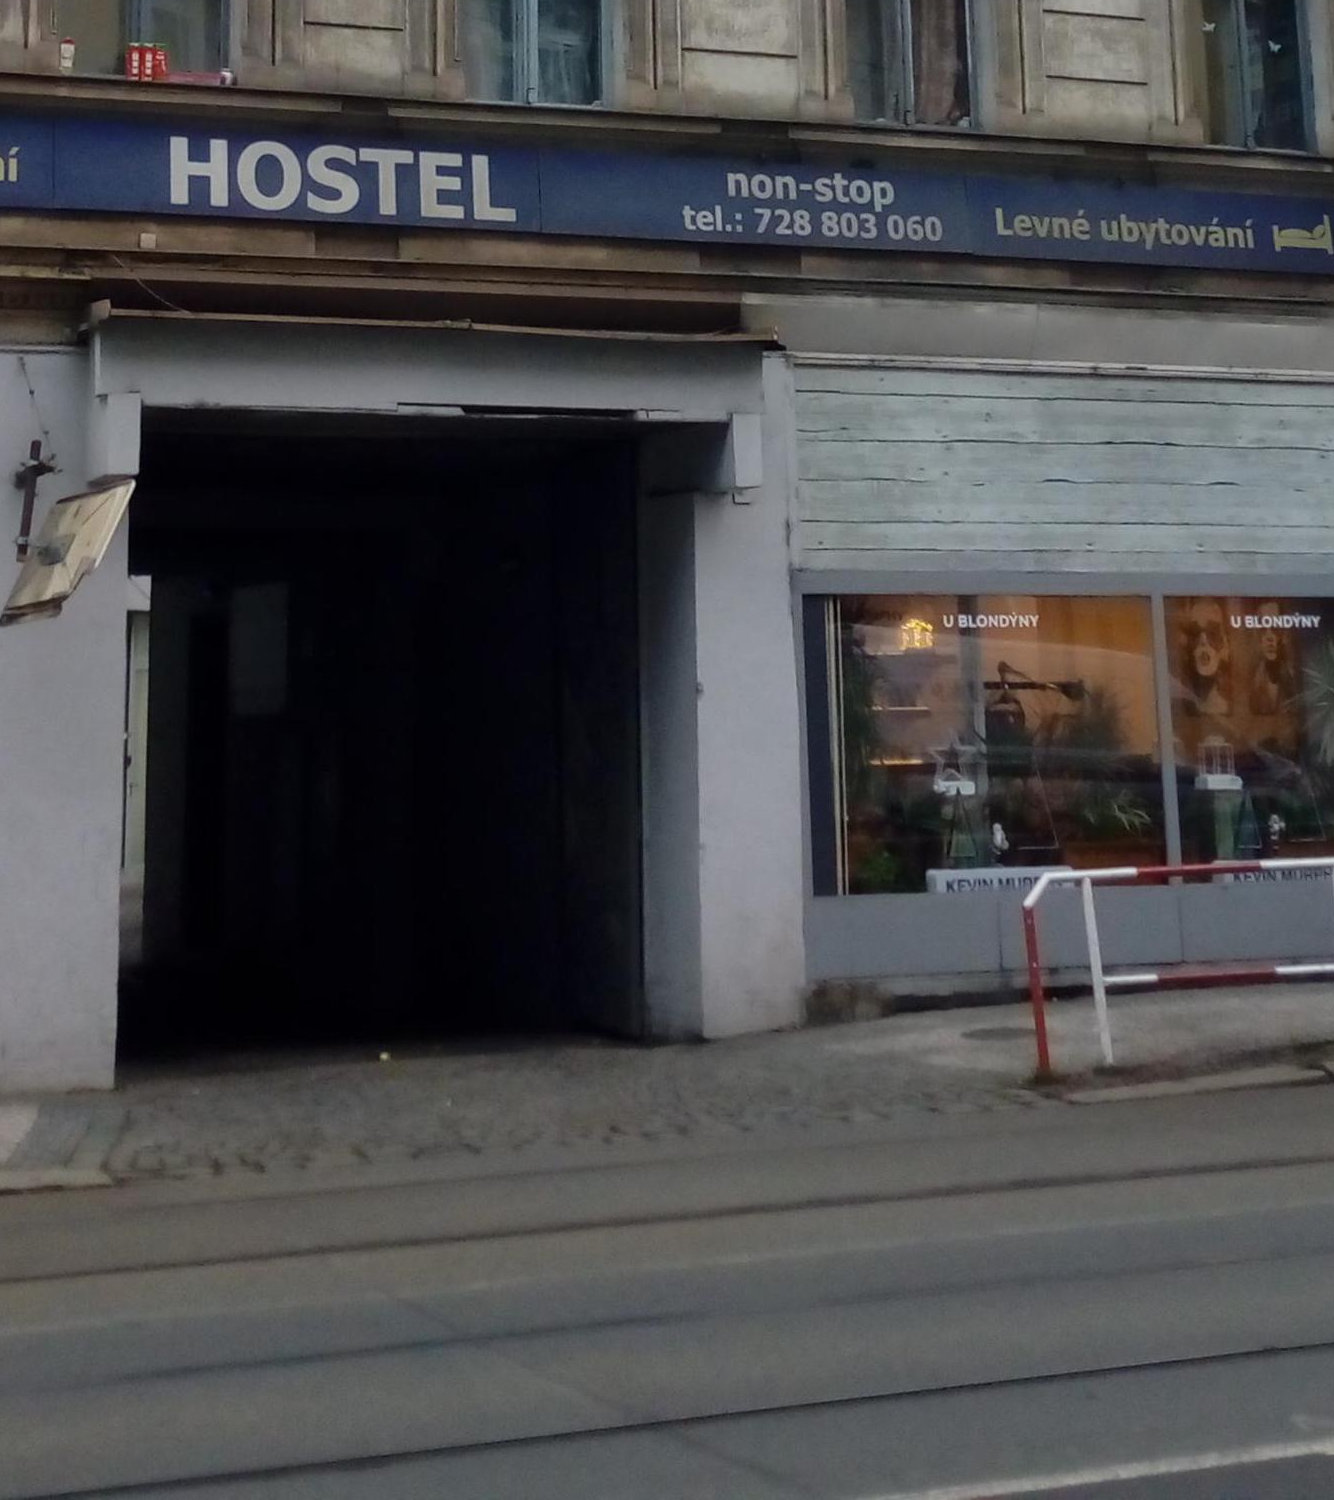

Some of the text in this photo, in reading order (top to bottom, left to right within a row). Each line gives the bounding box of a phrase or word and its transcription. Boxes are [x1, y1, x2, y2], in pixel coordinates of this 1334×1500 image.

[169, 135, 518, 223] HOSTEL
[726, 171, 895, 212] non-stop
[682, 204, 943, 242] tel.: 728 803 060
[994, 207, 1255, 250] Levné ubytování
[942, 611, 1039, 629] U BLONDÝNY
[1230, 612, 1321, 629] U BLONDÝNY
